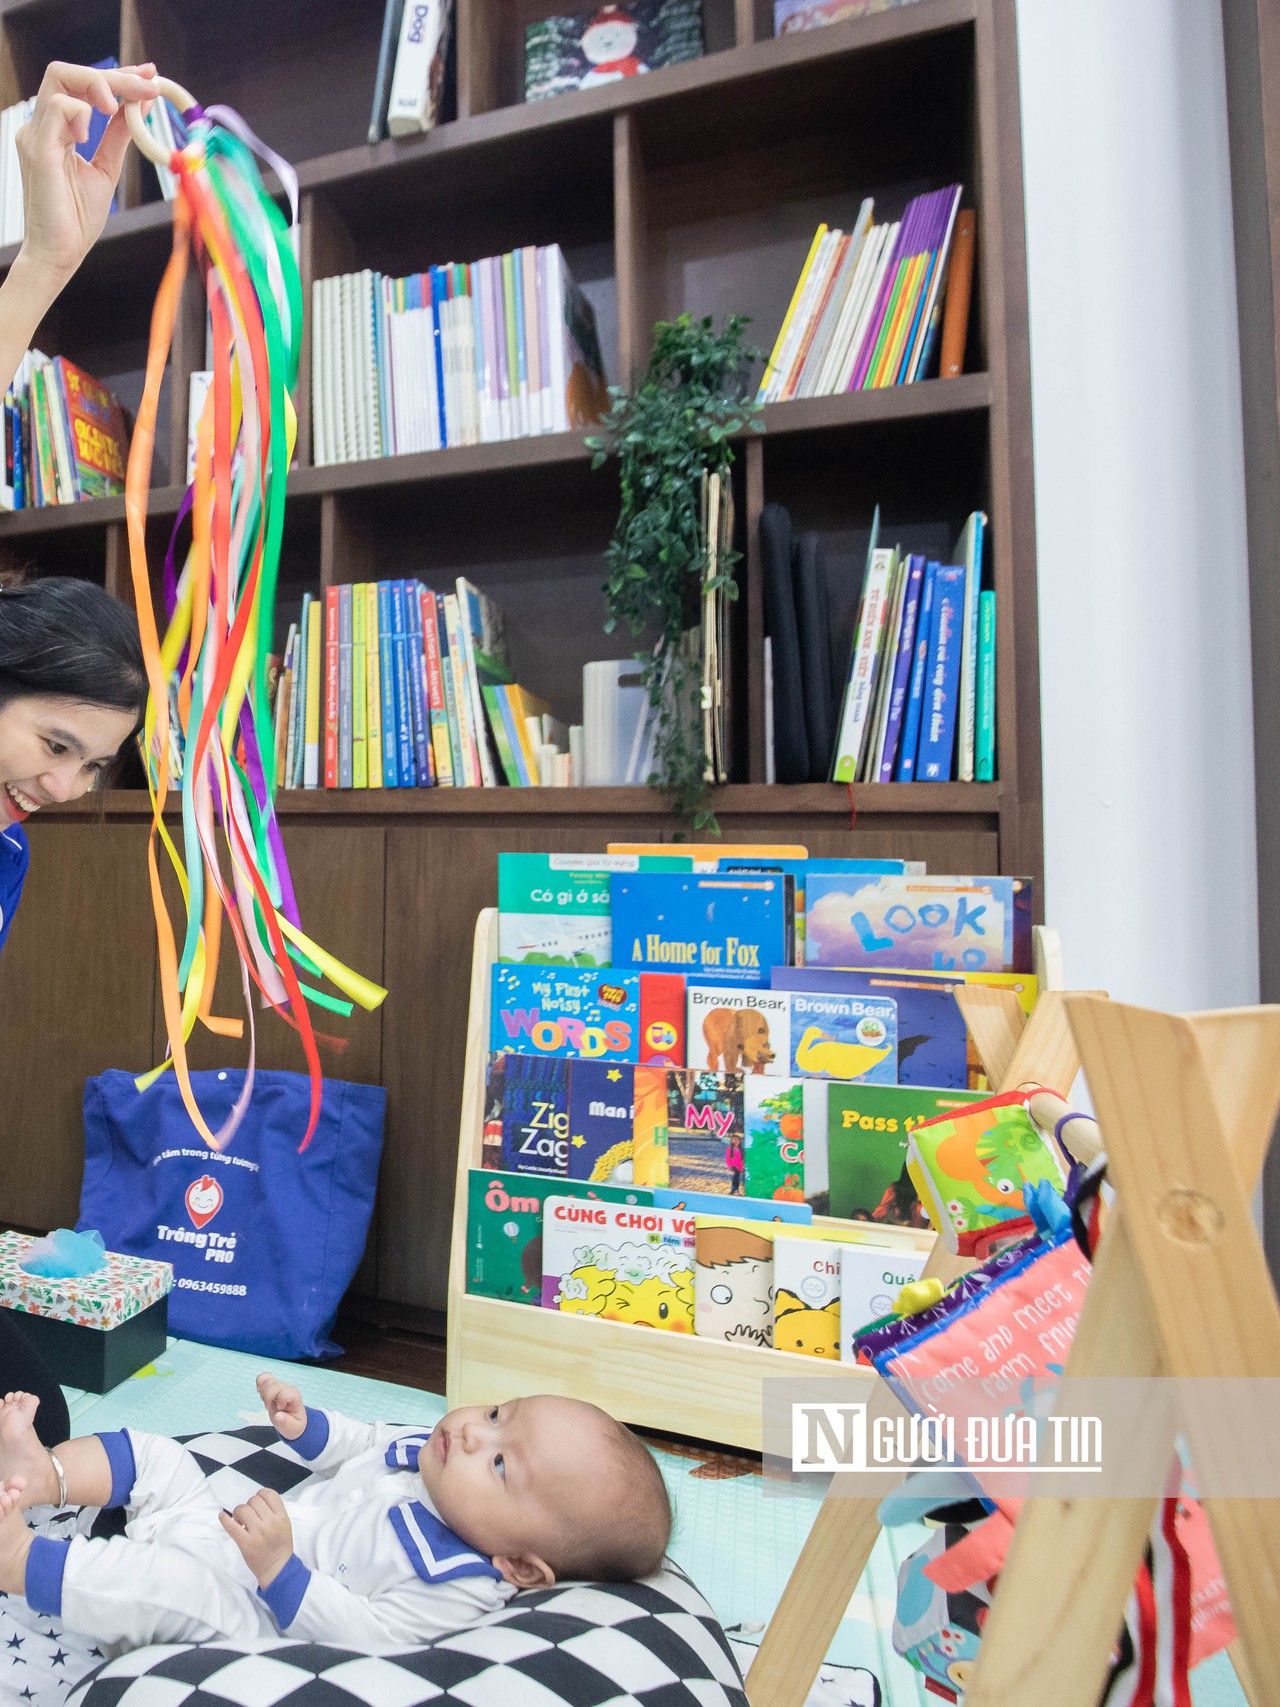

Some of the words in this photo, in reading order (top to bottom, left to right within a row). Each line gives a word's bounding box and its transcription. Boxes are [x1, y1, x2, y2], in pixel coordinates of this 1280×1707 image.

[408, 5, 428, 42] Dog
[632, 938, 643, 962] A
[646, 934, 697, 965] Home
[700, 940, 723, 966] for
[726, 937, 761, 967] Fox
[531, 981, 552, 998] My
[554, 982, 590, 998] First
[541, 996, 582, 1015] Noisy
[693, 992, 744, 1008] Brown
[746, 995, 787, 1013] Bear,
[794, 998, 850, 1015] Brown
[852, 1001, 895, 1020] Bear,
[500, 1007, 632, 1058] WORDS
[529, 1101, 569, 1139] Zig
[588, 1101, 627, 1119] Man
[685, 1103, 736, 1138] My
[841, 1109, 899, 1133] Pass
[181, 1148, 209, 1160] trong
[484, 1180, 540, 1213] Ôm
[205, 1248, 235, 1264] PRO
[177, 1278, 247, 1297] 0963459888
[1012, 1282, 1072, 1330] meet
